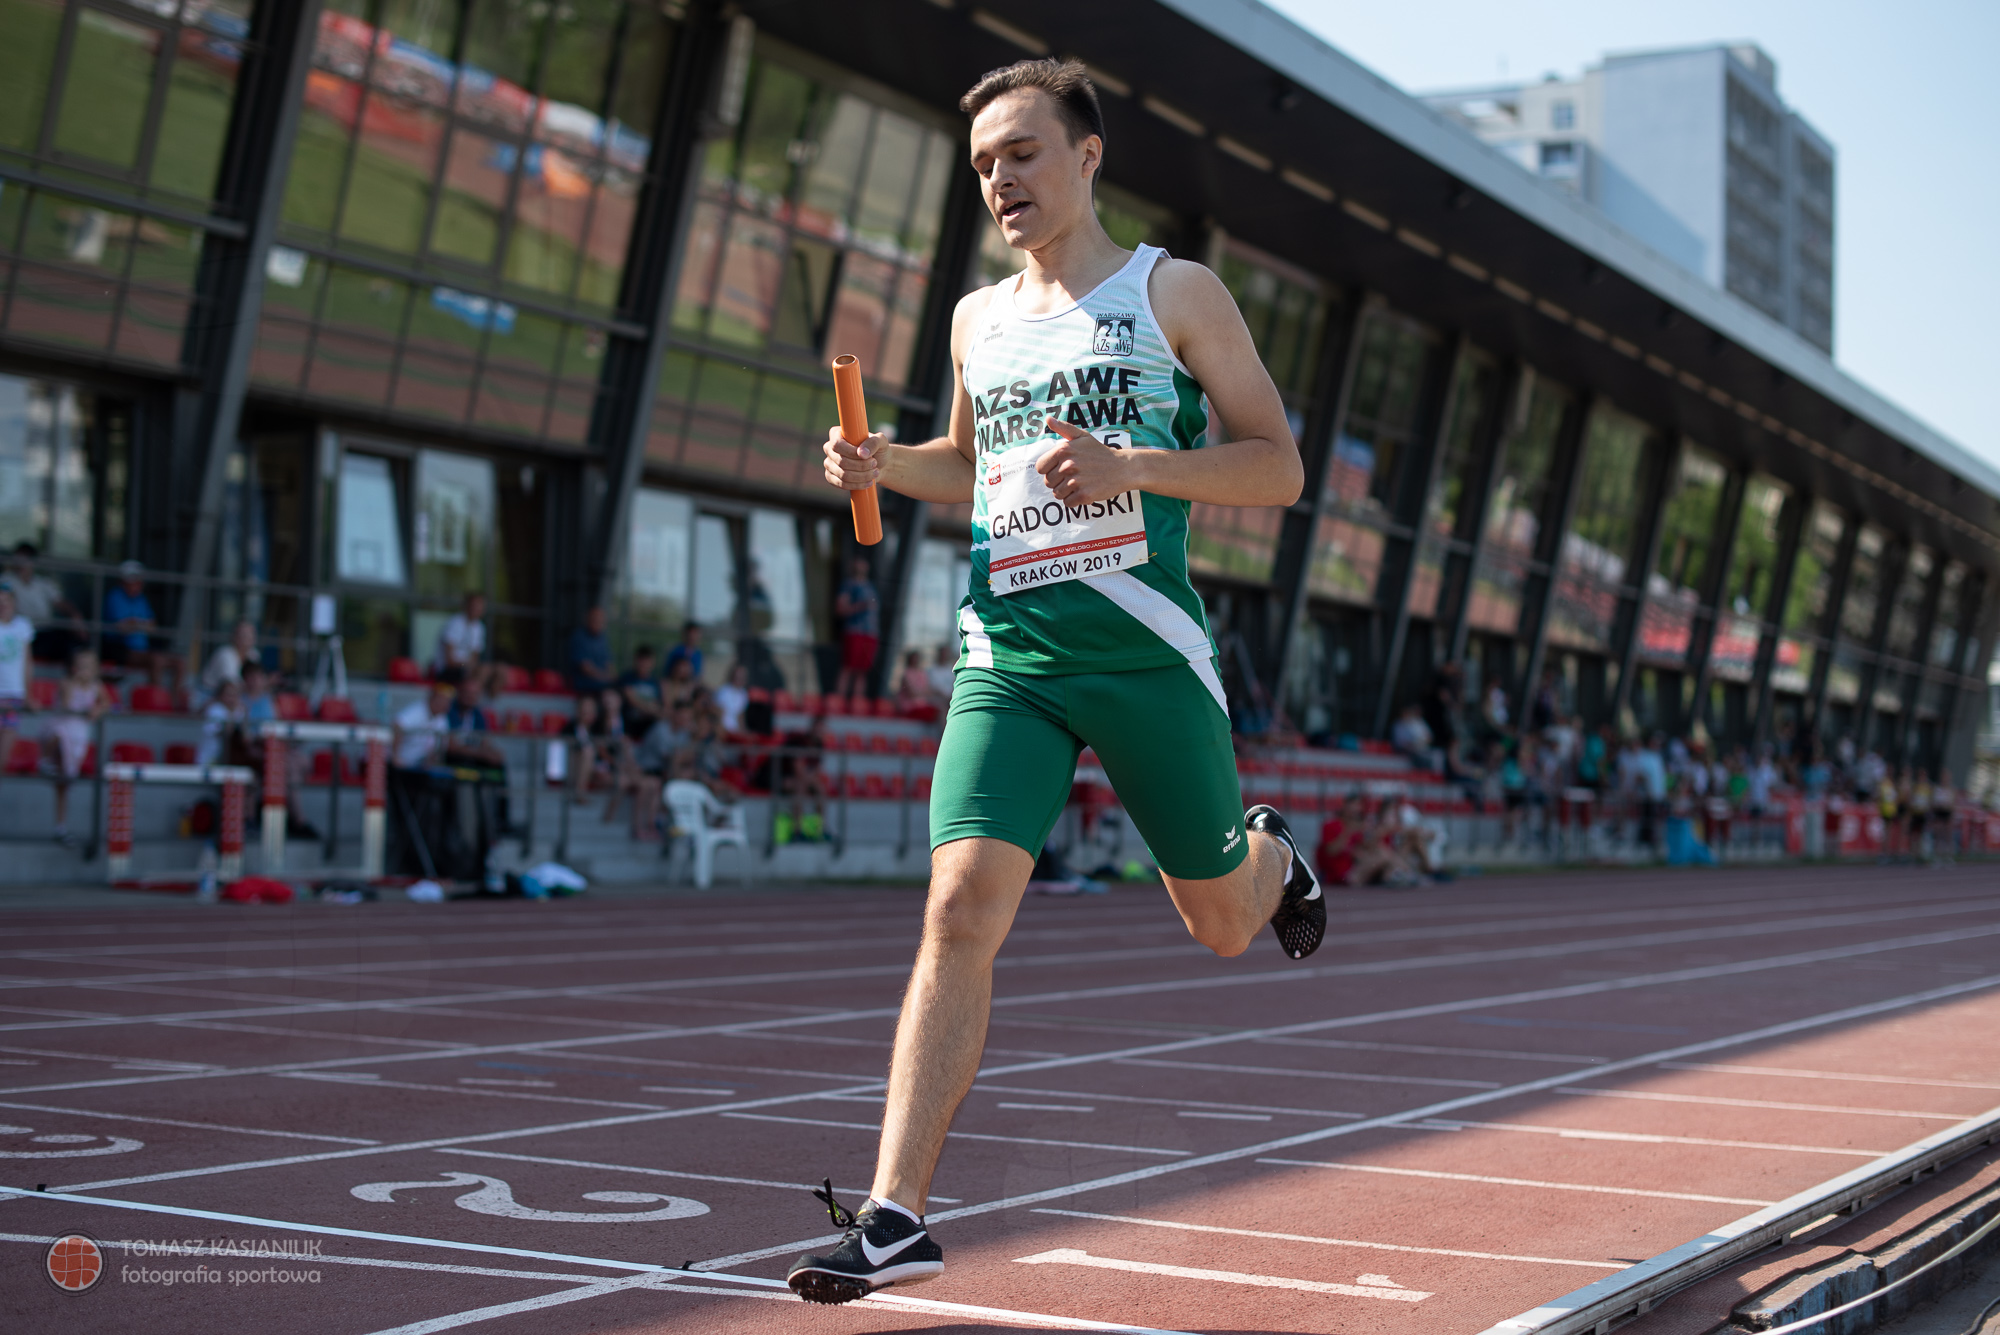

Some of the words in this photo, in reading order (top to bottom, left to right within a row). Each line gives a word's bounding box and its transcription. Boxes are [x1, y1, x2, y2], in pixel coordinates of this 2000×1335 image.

[1095, 339, 1110, 352] AZS
[1113, 339, 1132, 353] AWF
[975, 380, 1032, 424] AZS
[1047, 367, 1141, 401] AWF
[978, 397, 1144, 456] WARSZAWA
[993, 489, 1134, 539] GADOMSKI
[1010, 560, 1077, 587] KRAKÓW
[1083, 552, 1122, 573] 2019
[1039, 550, 1059, 558] POLSKI
[1222, 835, 1241, 854] erima
